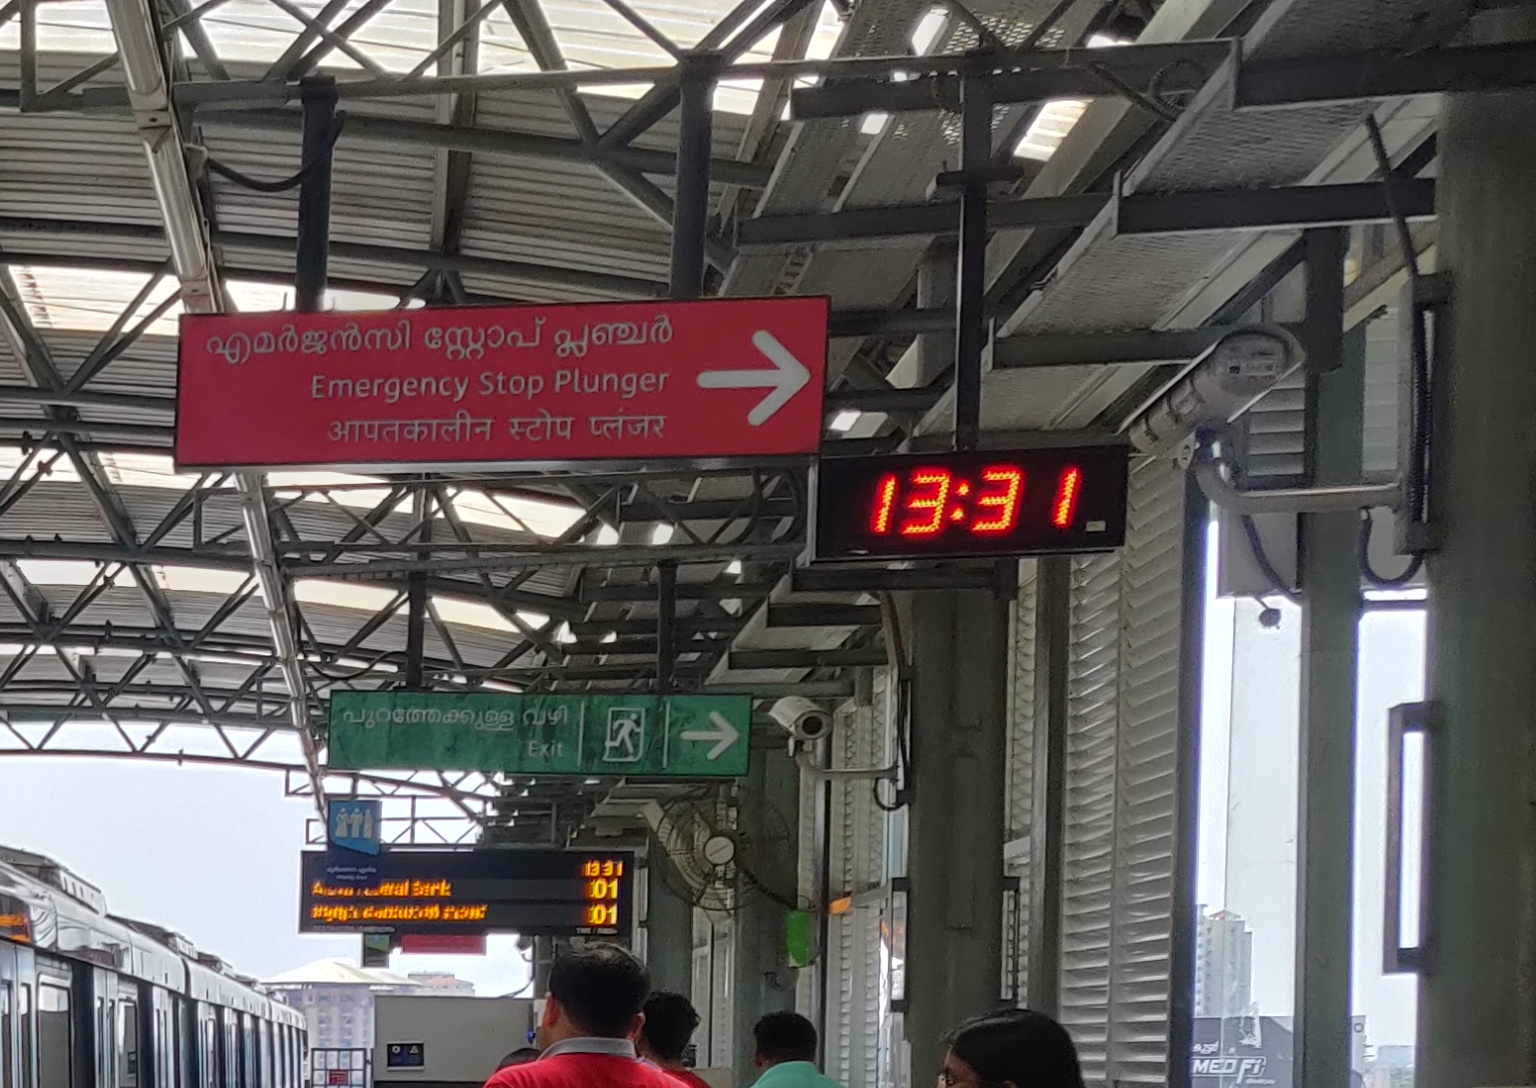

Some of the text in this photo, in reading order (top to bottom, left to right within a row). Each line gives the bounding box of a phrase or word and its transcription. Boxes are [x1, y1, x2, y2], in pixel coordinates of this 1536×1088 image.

[311, 368, 670, 402] Emergency Stop Plunger
[328, 407, 669, 442] आपतकालीन स्टोप प्लंजर
[874, 466, 1078, 535] 13:31
[343, 705, 569, 731] പുറത്തേക്കുള്ള വഴി
[529, 739, 564, 757] Exit
